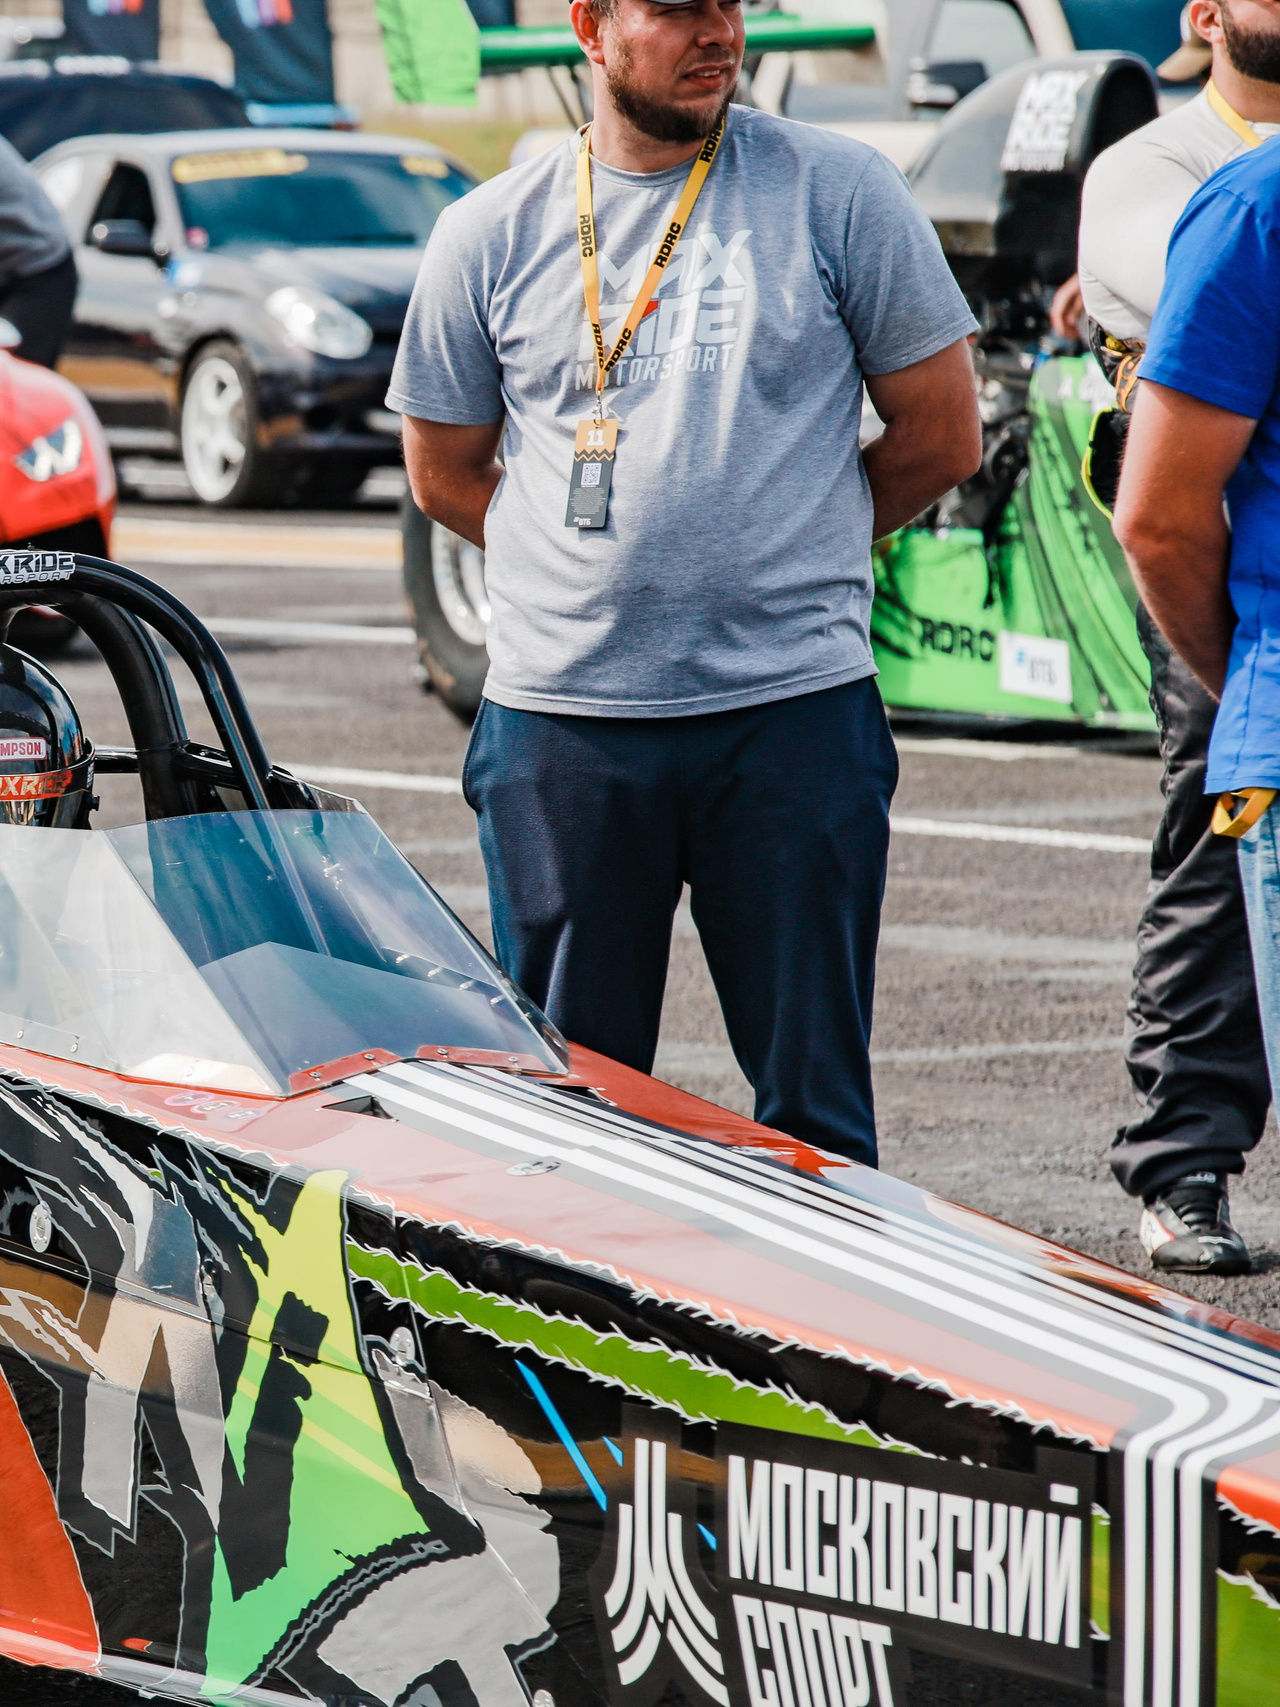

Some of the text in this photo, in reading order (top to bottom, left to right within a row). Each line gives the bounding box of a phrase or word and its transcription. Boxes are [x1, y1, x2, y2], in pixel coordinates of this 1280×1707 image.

[580, 214, 594, 257] RDRC
[654, 221, 681, 268] RDRC
[592, 323, 605, 369] RDRC
[604, 327, 632, 372] RDRC
[586, 429, 604, 446] 11
[921, 618, 995, 662] RDRC
[728, 1455, 1081, 1648] МОСКОВСКИЙ
[732, 1594, 894, 1707] СПОРТ
